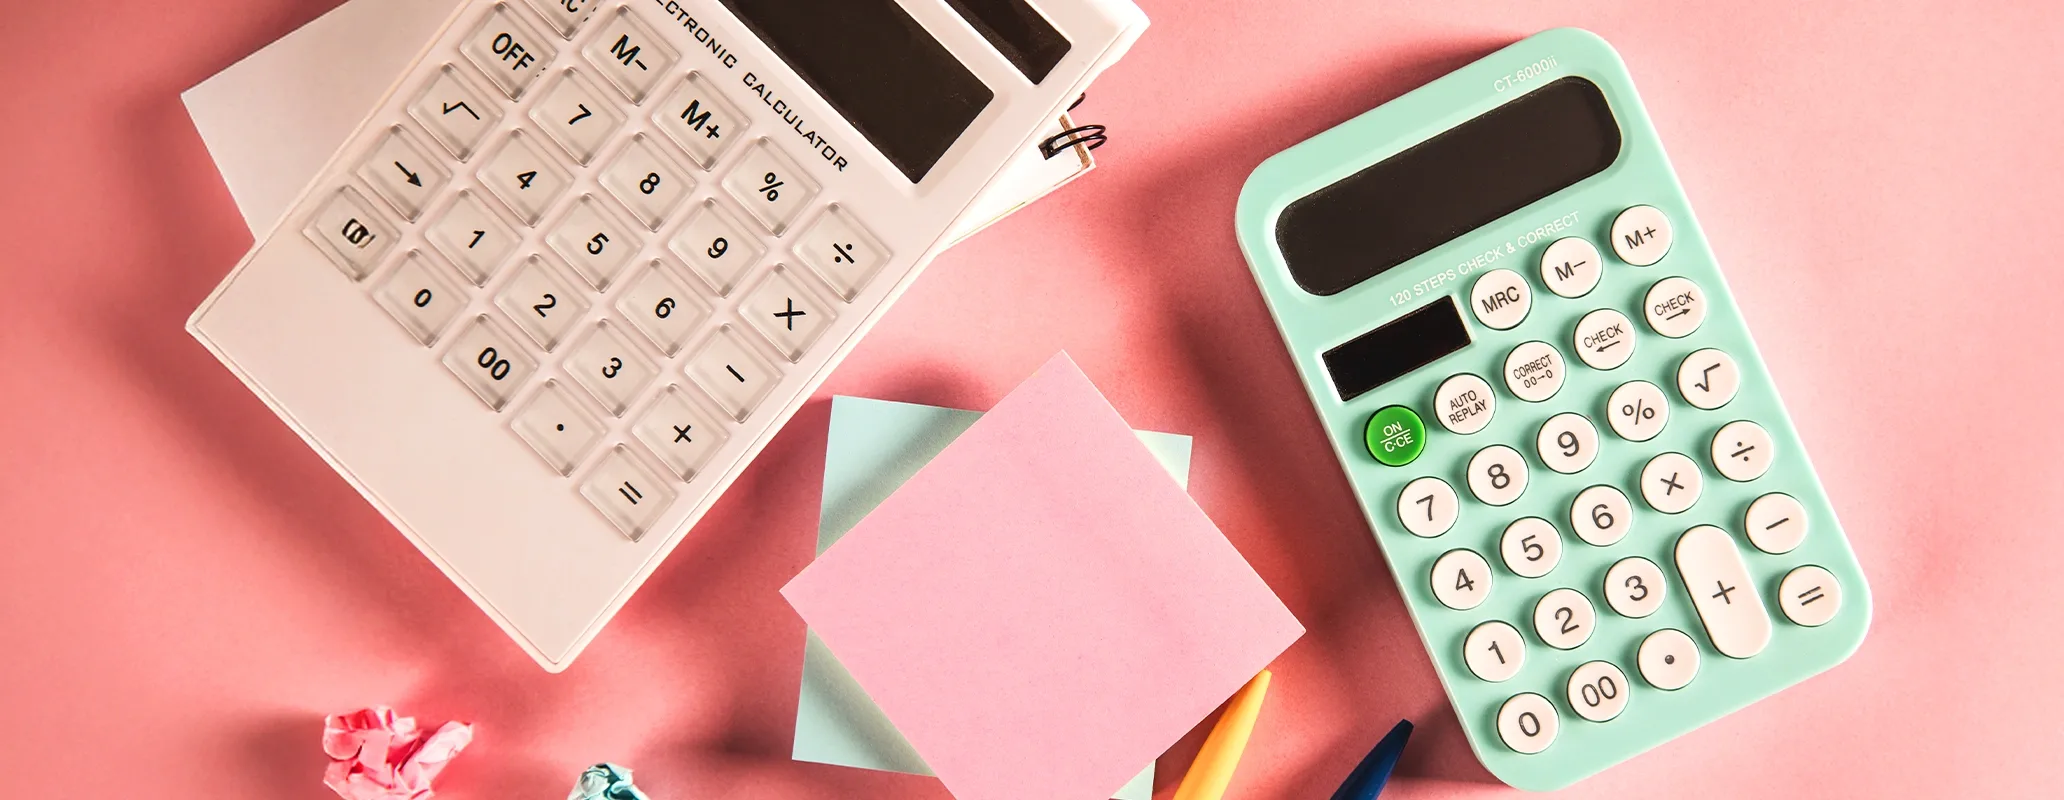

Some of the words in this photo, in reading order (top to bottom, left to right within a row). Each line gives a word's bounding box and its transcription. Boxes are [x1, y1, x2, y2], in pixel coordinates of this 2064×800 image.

[492, 33, 534, 70] OFF
[1492, 54, 1559, 94] CT-6000ii
[569, 104, 591, 125] 7
[681, 100, 719, 138] M+
[742, 71, 849, 173] CALCULATOR
[517, 171, 537, 189] 4
[640, 173, 660, 194] 8
[759, 173, 784, 201] %
[469, 231, 485, 248] 1
[587, 233, 609, 254] 5
[708, 238, 728, 258] 9
[1625, 227, 1656, 249] M+
[1389, 288, 1412, 308] 120
[1412, 268, 1458, 298] STEPS
[1457, 246, 1505, 276] CHECK
[1505, 241, 1517, 255] &
[1516, 210, 1580, 250] CORRECT
[414, 289, 432, 307] 0
[533, 294, 556, 317] 2
[656, 298, 675, 318] 6
[1481, 285, 1521, 315] MRC
[1654, 290, 1695, 317] CHECK
[1584, 323, 1624, 350] CHECK
[478, 347, 510, 380] 00
[603, 358, 622, 378] 3
[1512, 353, 1554, 381] CORRECT
[1448, 398, 1488, 426] REPLAY
[1449, 389, 1478, 411] AUTO
[1623, 399, 1655, 425] %
[1383, 420, 1403, 437] ON
[1558, 431, 1579, 457] 9
[1488, 464, 1510, 489] 8
[1415, 495, 1433, 521] 7
[1592, 504, 1614, 529] 6
[1522, 535, 1543, 561] 5
[1456, 568, 1474, 591] 4
[1625, 576, 1648, 601] 3
[1555, 607, 1579, 634] 2
[1488, 641, 1505, 664] 1
[1582, 676, 1617, 707] 00
[1519, 712, 1540, 737] 0
